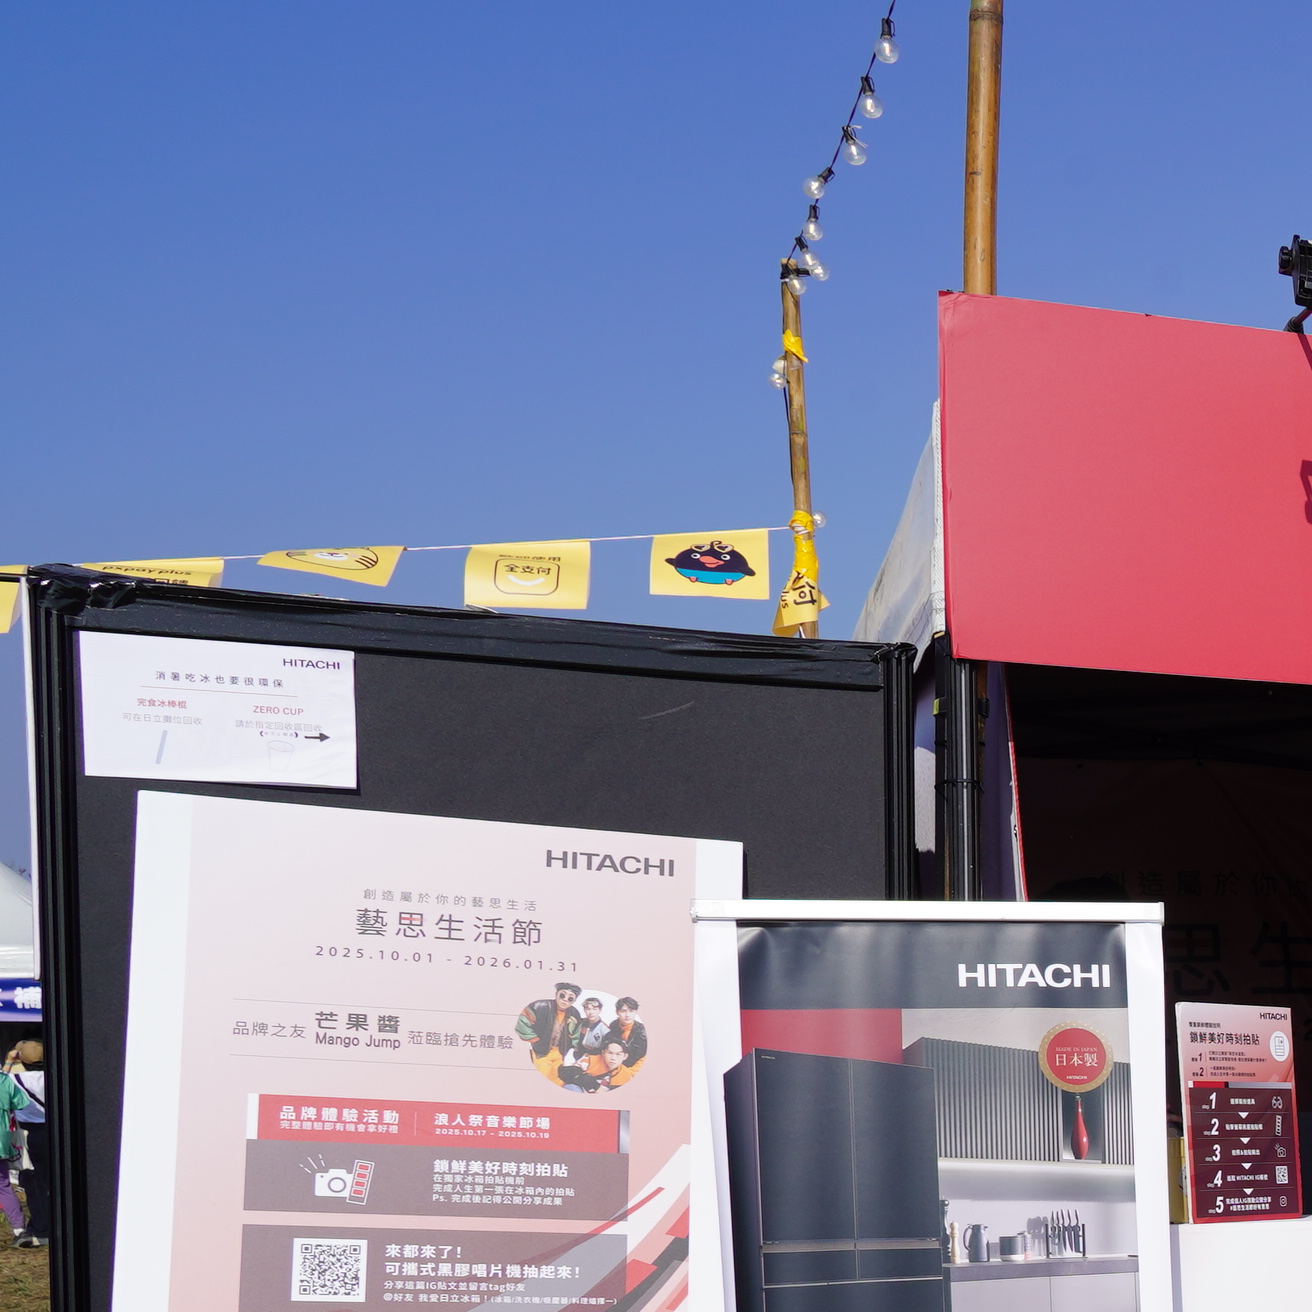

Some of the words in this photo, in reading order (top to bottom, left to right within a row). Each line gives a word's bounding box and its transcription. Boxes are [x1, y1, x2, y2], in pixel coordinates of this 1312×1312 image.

[103, 565, 156, 574] pxpay
[505, 564, 551, 575] 全支付
[283, 659, 340, 669] HITACHI
[156, 670, 284, 688] 消暑吃冰也要很環保
[137, 698, 187, 709] 完食冰棒棍
[253, 706, 280, 714] ZERO
[283, 707, 304, 716] CUP
[123, 713, 203, 725] 可在日立攤位回收
[235, 720, 322, 732] 請於指定回收區回收
[546, 850, 675, 877] HITACHI
[363, 888, 537, 912] 創造屬於你的藝思生活
[356, 908, 543, 947] 藝思生活節
[316, 945, 434, 964] 2025.10.01
[464, 955, 579, 972] 2026.01.31
[958, 963, 1111, 989] HITACHI
[233, 1020, 306, 1040] 品牌之友
[315, 1011, 401, 1034] 芒果醬
[407, 1030, 514, 1050] 蒞臨搶先體驗
[1190, 1032, 1260, 1045] 鎖鮮美好時刻拍貼
[315, 1031, 360, 1049] Mango
[366, 1035, 401, 1051] Jump
[1056, 1053, 1098, 1067] 日本製
[1199, 1067, 1204, 1076] 2
[1210, 1092, 1216, 1109] 1
[279, 1105, 400, 1124] 品牌體驗活動
[434, 1113, 551, 1131] 浪人祭音樂節場
[280, 1120, 399, 1135] 完整體驗即有機會拿好禮
[435, 1127, 486, 1137] 2025.10.17
[1211, 1118, 1219, 1135] 2
[1213, 1144, 1220, 1161] 3
[433, 1159, 569, 1178] 鎖鮮美好時刻拍貼
[1214, 1170, 1222, 1187] 4
[432, 1184, 575, 1197] 完成人生第一張在冰箱內的拍貼
[432, 1193, 448, 1203] Ps.
[1216, 1197, 1224, 1213] 5
[385, 1244, 462, 1259] 來都來了!
[385, 1262, 580, 1279] 可攜式黑膠唱片機抽起來!
[384, 1280, 526, 1292] 分享這篇IG貼文並留言tag好友
